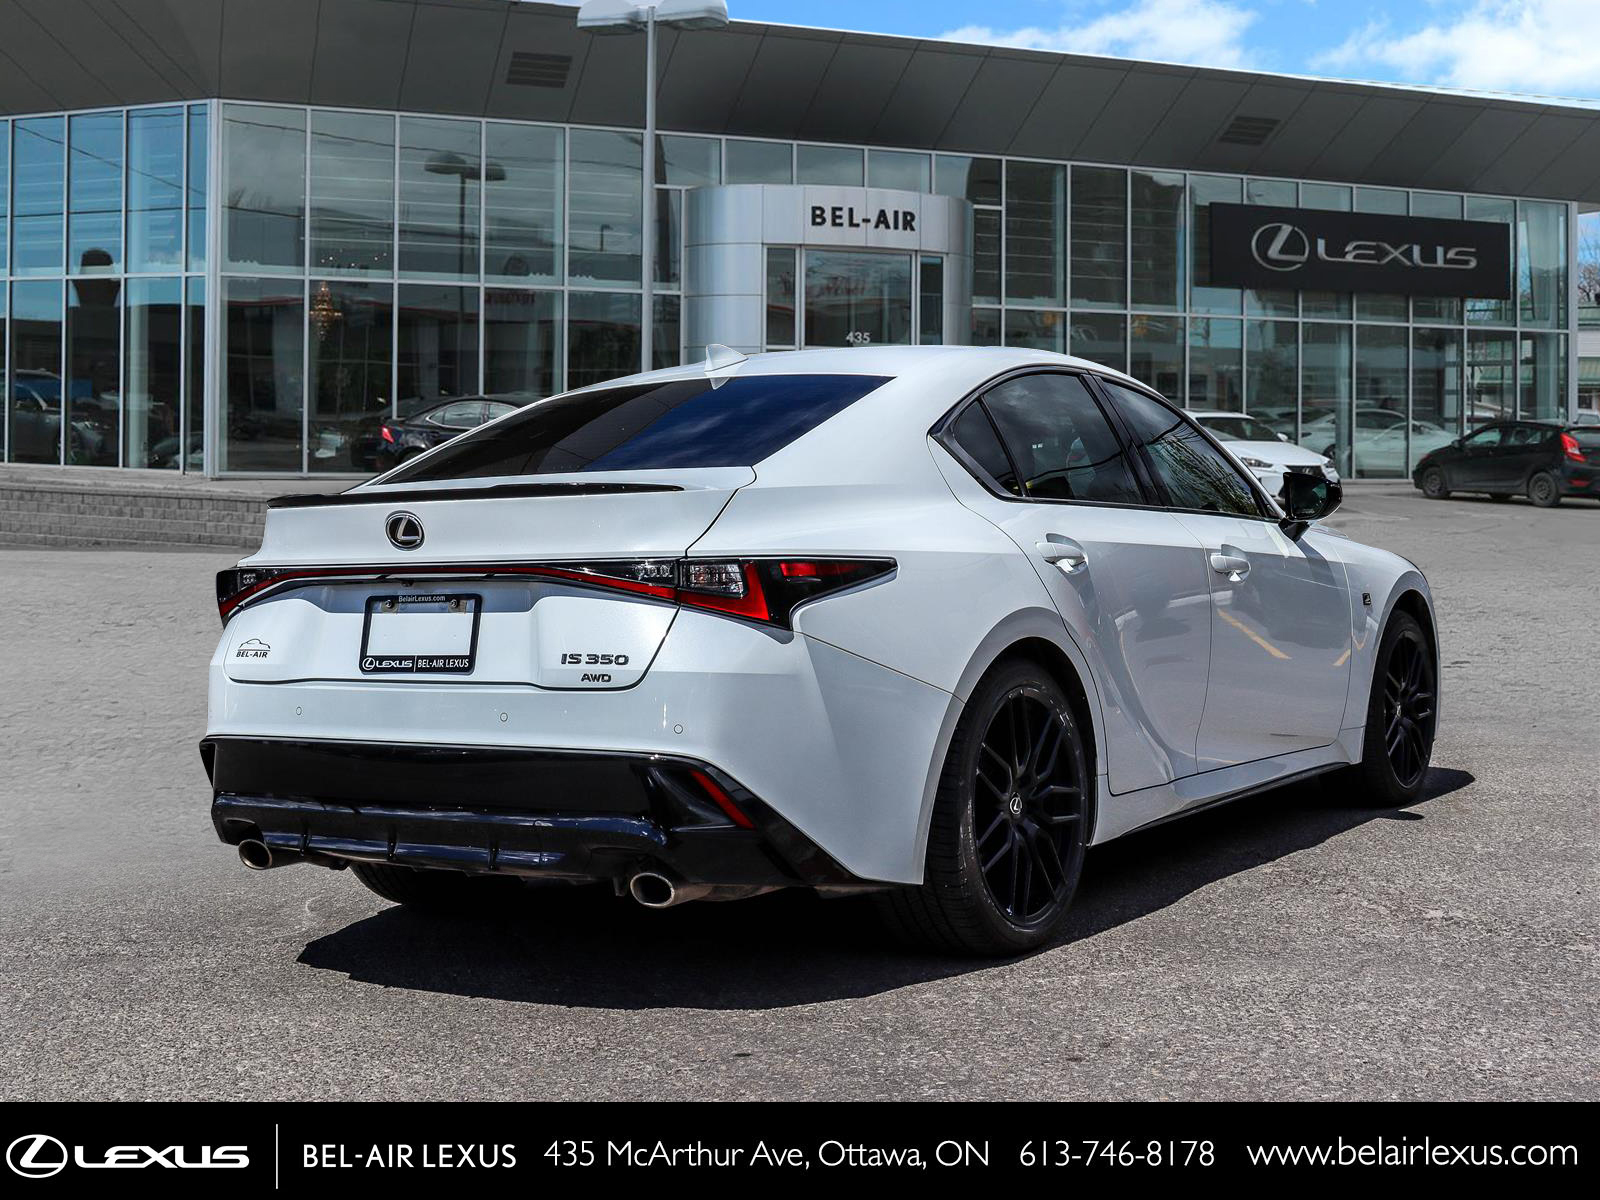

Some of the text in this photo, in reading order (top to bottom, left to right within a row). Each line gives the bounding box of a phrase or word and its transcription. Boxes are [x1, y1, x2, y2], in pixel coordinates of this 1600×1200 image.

[811, 206, 916, 232] BEL-AIR
[1317, 237, 1478, 270] LEXUS
[846, 331, 871, 344] 435
[398, 594, 446, 603] BelairLexus.com
[236, 651, 268, 659] BEL-AIR
[561, 653, 630, 666] IS 350
[376, 660, 413, 668] LEXUS
[417, 659, 469, 668] BEL-AIR LEXUS
[580, 673, 612, 683] AWD
